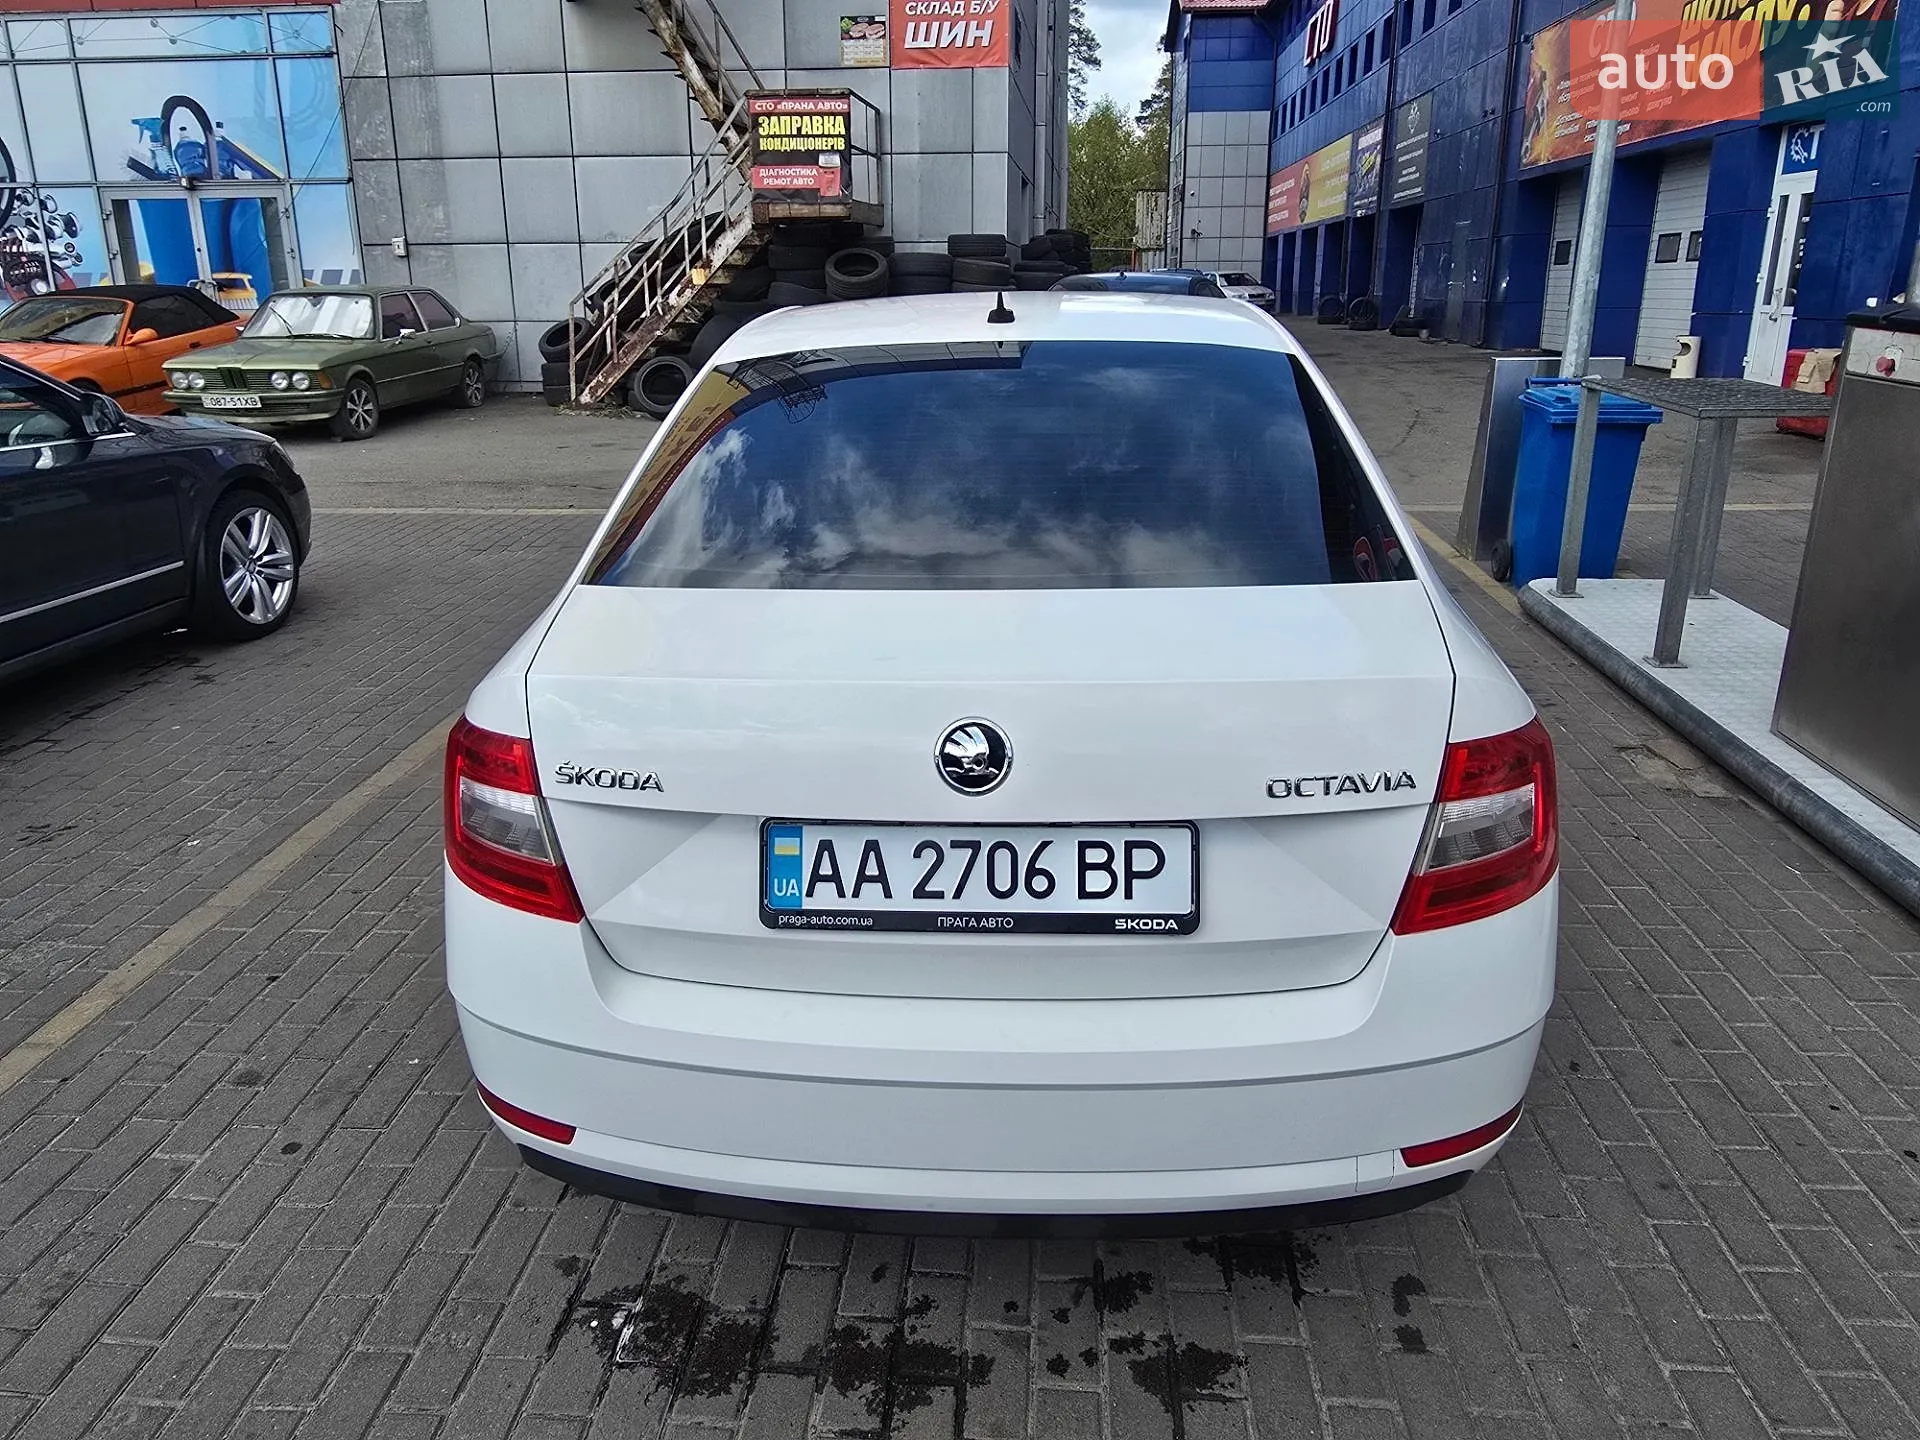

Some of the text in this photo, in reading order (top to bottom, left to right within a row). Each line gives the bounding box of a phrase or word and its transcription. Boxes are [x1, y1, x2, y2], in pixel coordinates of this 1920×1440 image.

[905, 0, 1000, 16] СКЛАД Б/У
[904, 19, 994, 49] ШИН
[755, 101, 775, 111] СТО
[758, 115, 846, 136] ЗАПРАВКА
[759, 137, 845, 152] КОНДИЦІОНЕРІВ
[759, 168, 819, 177] ДІАГНОСТИКА
[763, 177, 815, 186] РЕМОТ АВТО
[554, 760, 665, 793] ŠKODA
[1265, 770, 1417, 799] OCTAVIA
[804, 838, 1167, 901] AA 2706 BP
[773, 877, 801, 898] UA
[778, 914, 874, 927] praga-auto.com.ua
[937, 917, 1015, 929] ПРАГА АВТО
